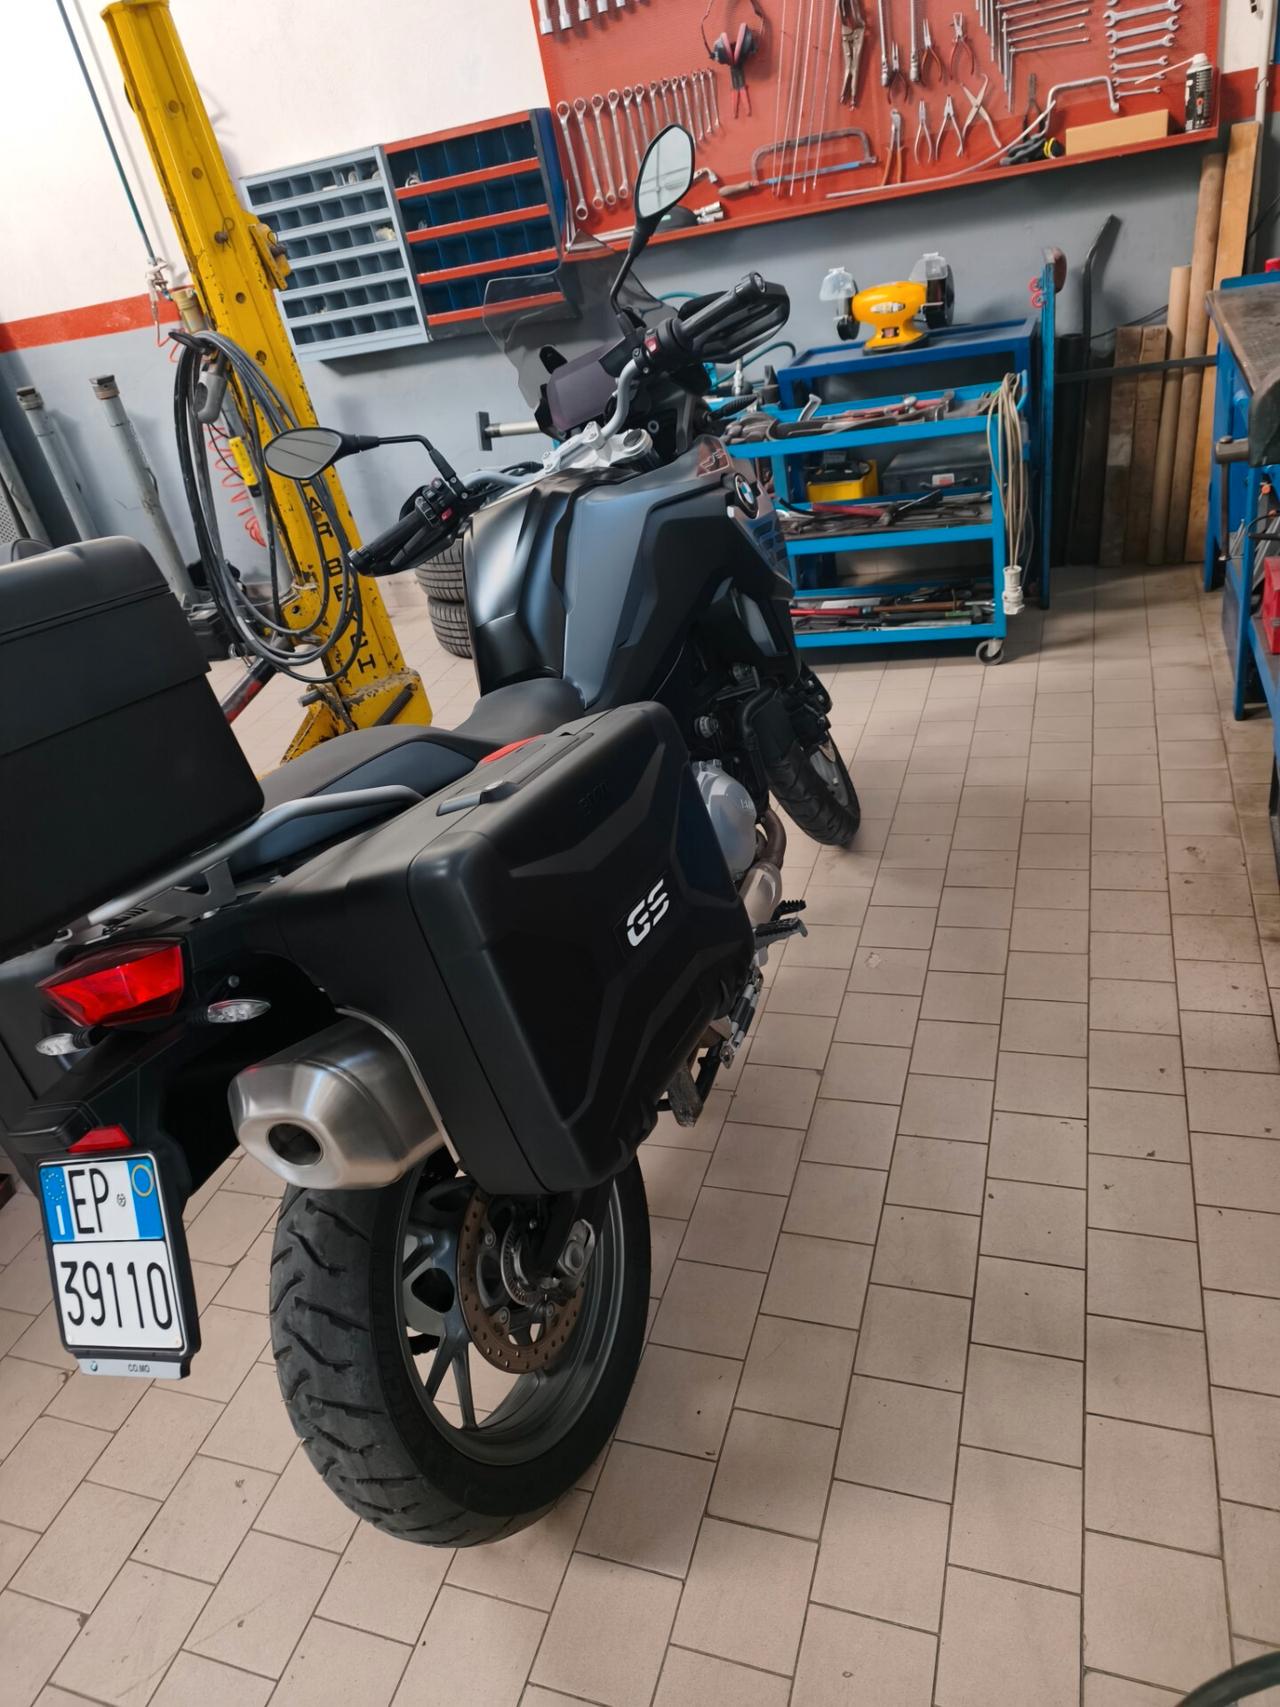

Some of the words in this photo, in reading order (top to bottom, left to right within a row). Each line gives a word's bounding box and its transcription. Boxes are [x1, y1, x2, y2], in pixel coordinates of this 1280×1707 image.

[627, 878, 670, 947] GS
[67, 1167, 110, 1235] EP
[60, 1260, 173, 1331] 39110
